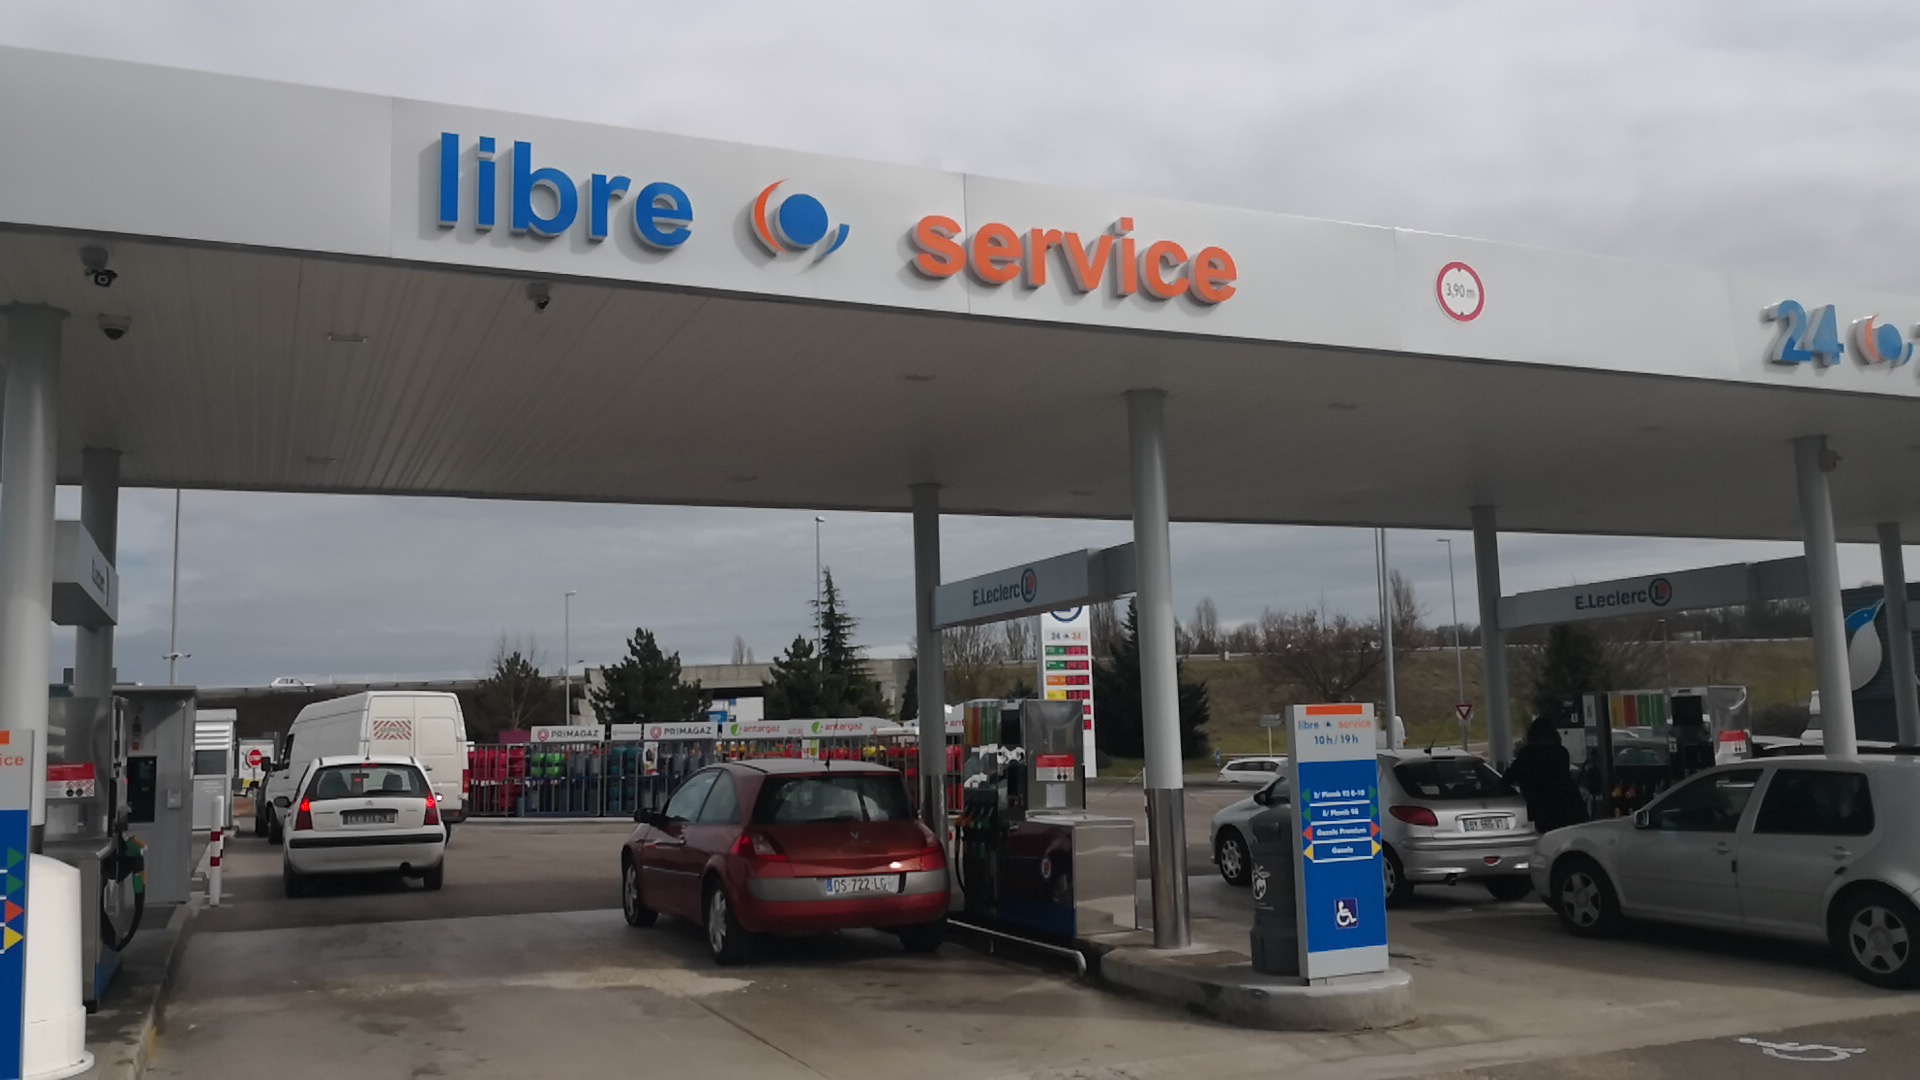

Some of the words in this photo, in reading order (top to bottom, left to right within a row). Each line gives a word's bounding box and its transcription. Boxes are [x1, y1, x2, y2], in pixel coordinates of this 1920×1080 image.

[439, 132, 694, 251] libre
[911, 214, 1238, 304] service
[1446, 282, 1465, 298] 3,90
[1467, 289, 1475, 298] m
[1768, 299, 1845, 366] 24
[973, 584, 1020, 607] E.Leclerc
[1574, 590, 1648, 610] E.Leclerc
[663, 726, 712, 735] PRIMAGAZ
[742, 723, 780, 734] antargaz
[824, 721, 863, 733] antargaz
[1298, 720, 1319, 729] libre
[1338, 720, 1372, 729] service
[551, 729, 600, 738] PRIMAGAZ
